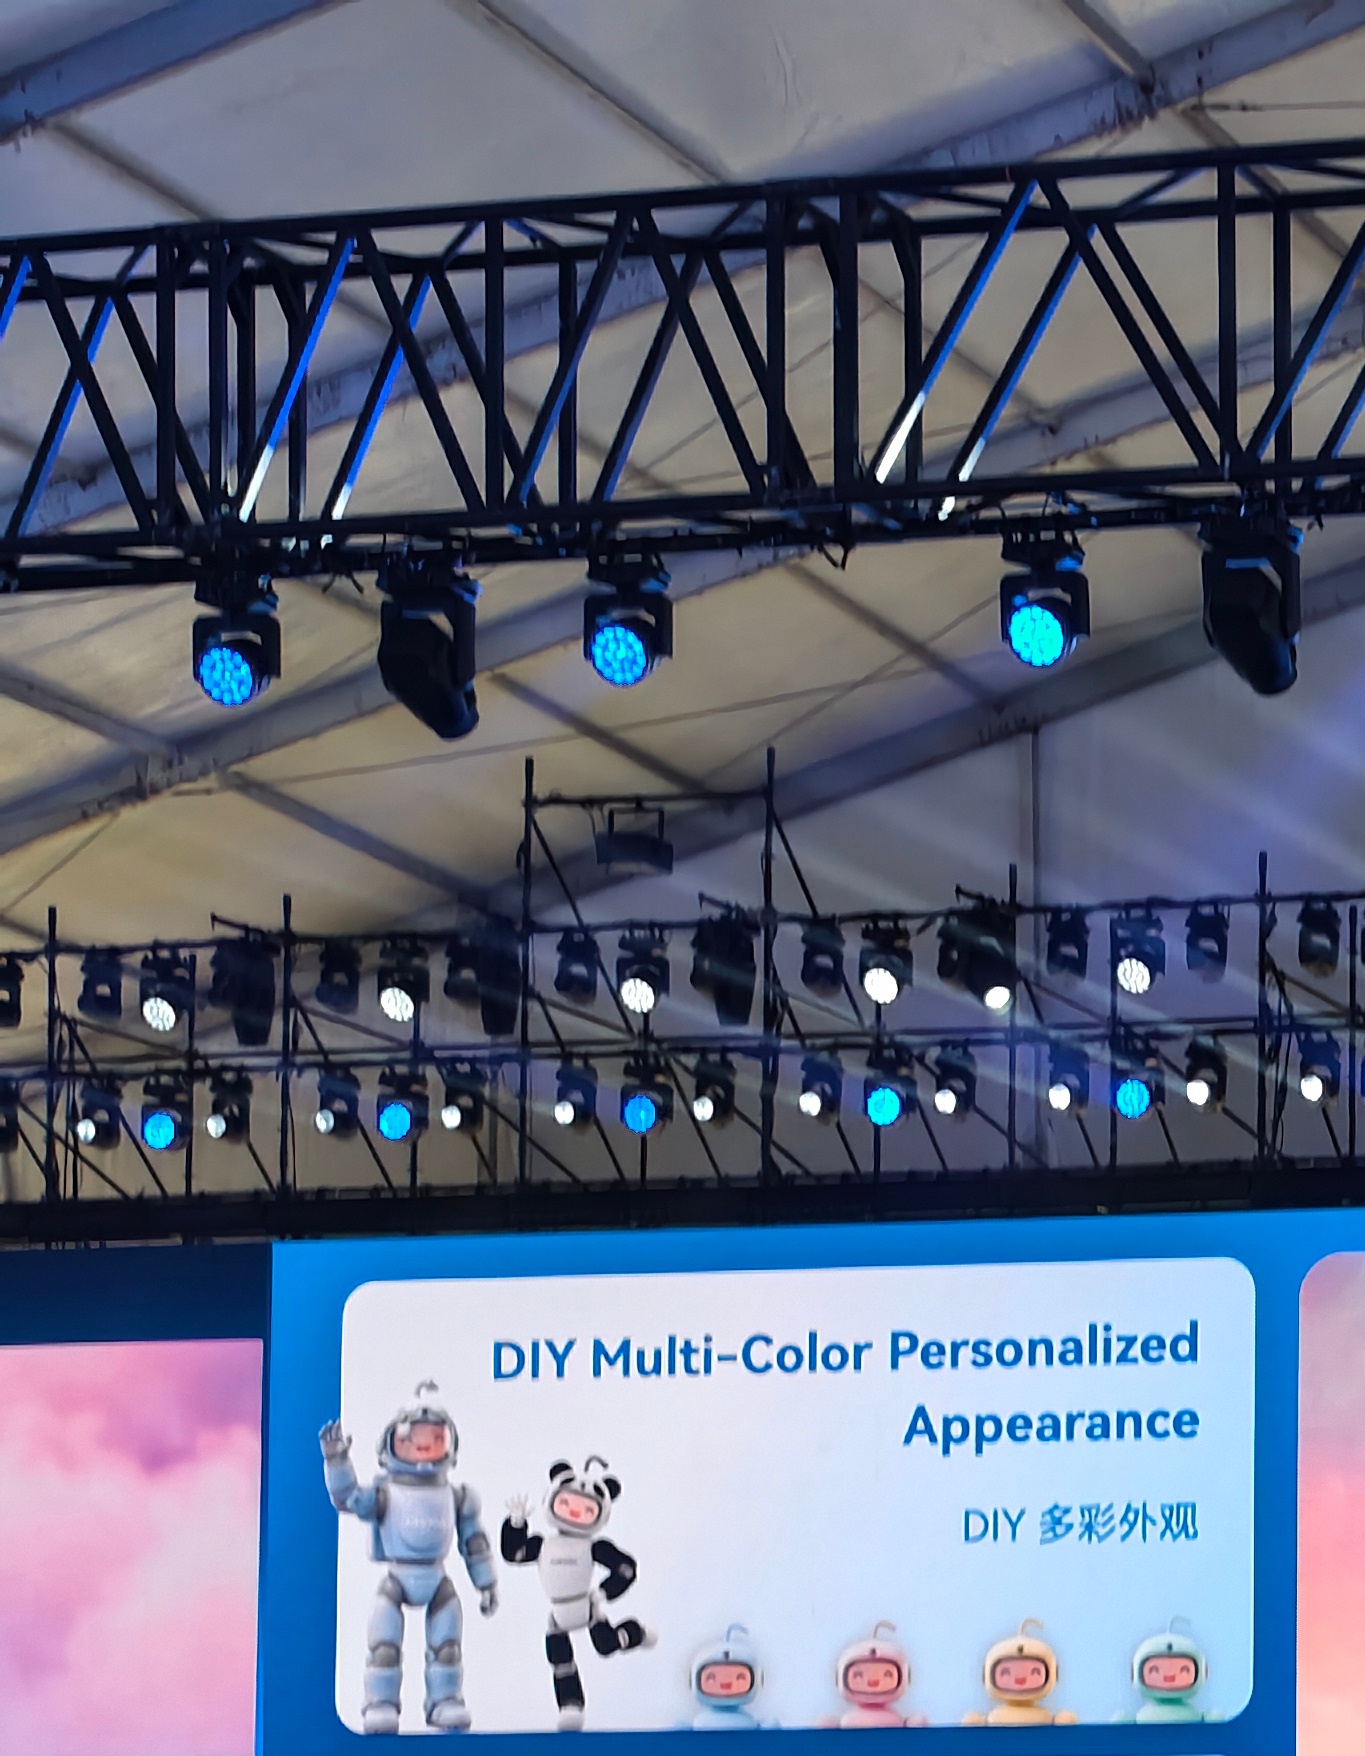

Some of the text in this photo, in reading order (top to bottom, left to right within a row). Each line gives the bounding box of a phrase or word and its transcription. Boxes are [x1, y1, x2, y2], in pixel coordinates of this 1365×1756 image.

[492, 1318, 1199, 1382] DIY Multi-Color Personalized
[902, 1403, 1200, 1459] Appearance
[963, 1499, 1199, 1546] DIY 多彩外观
